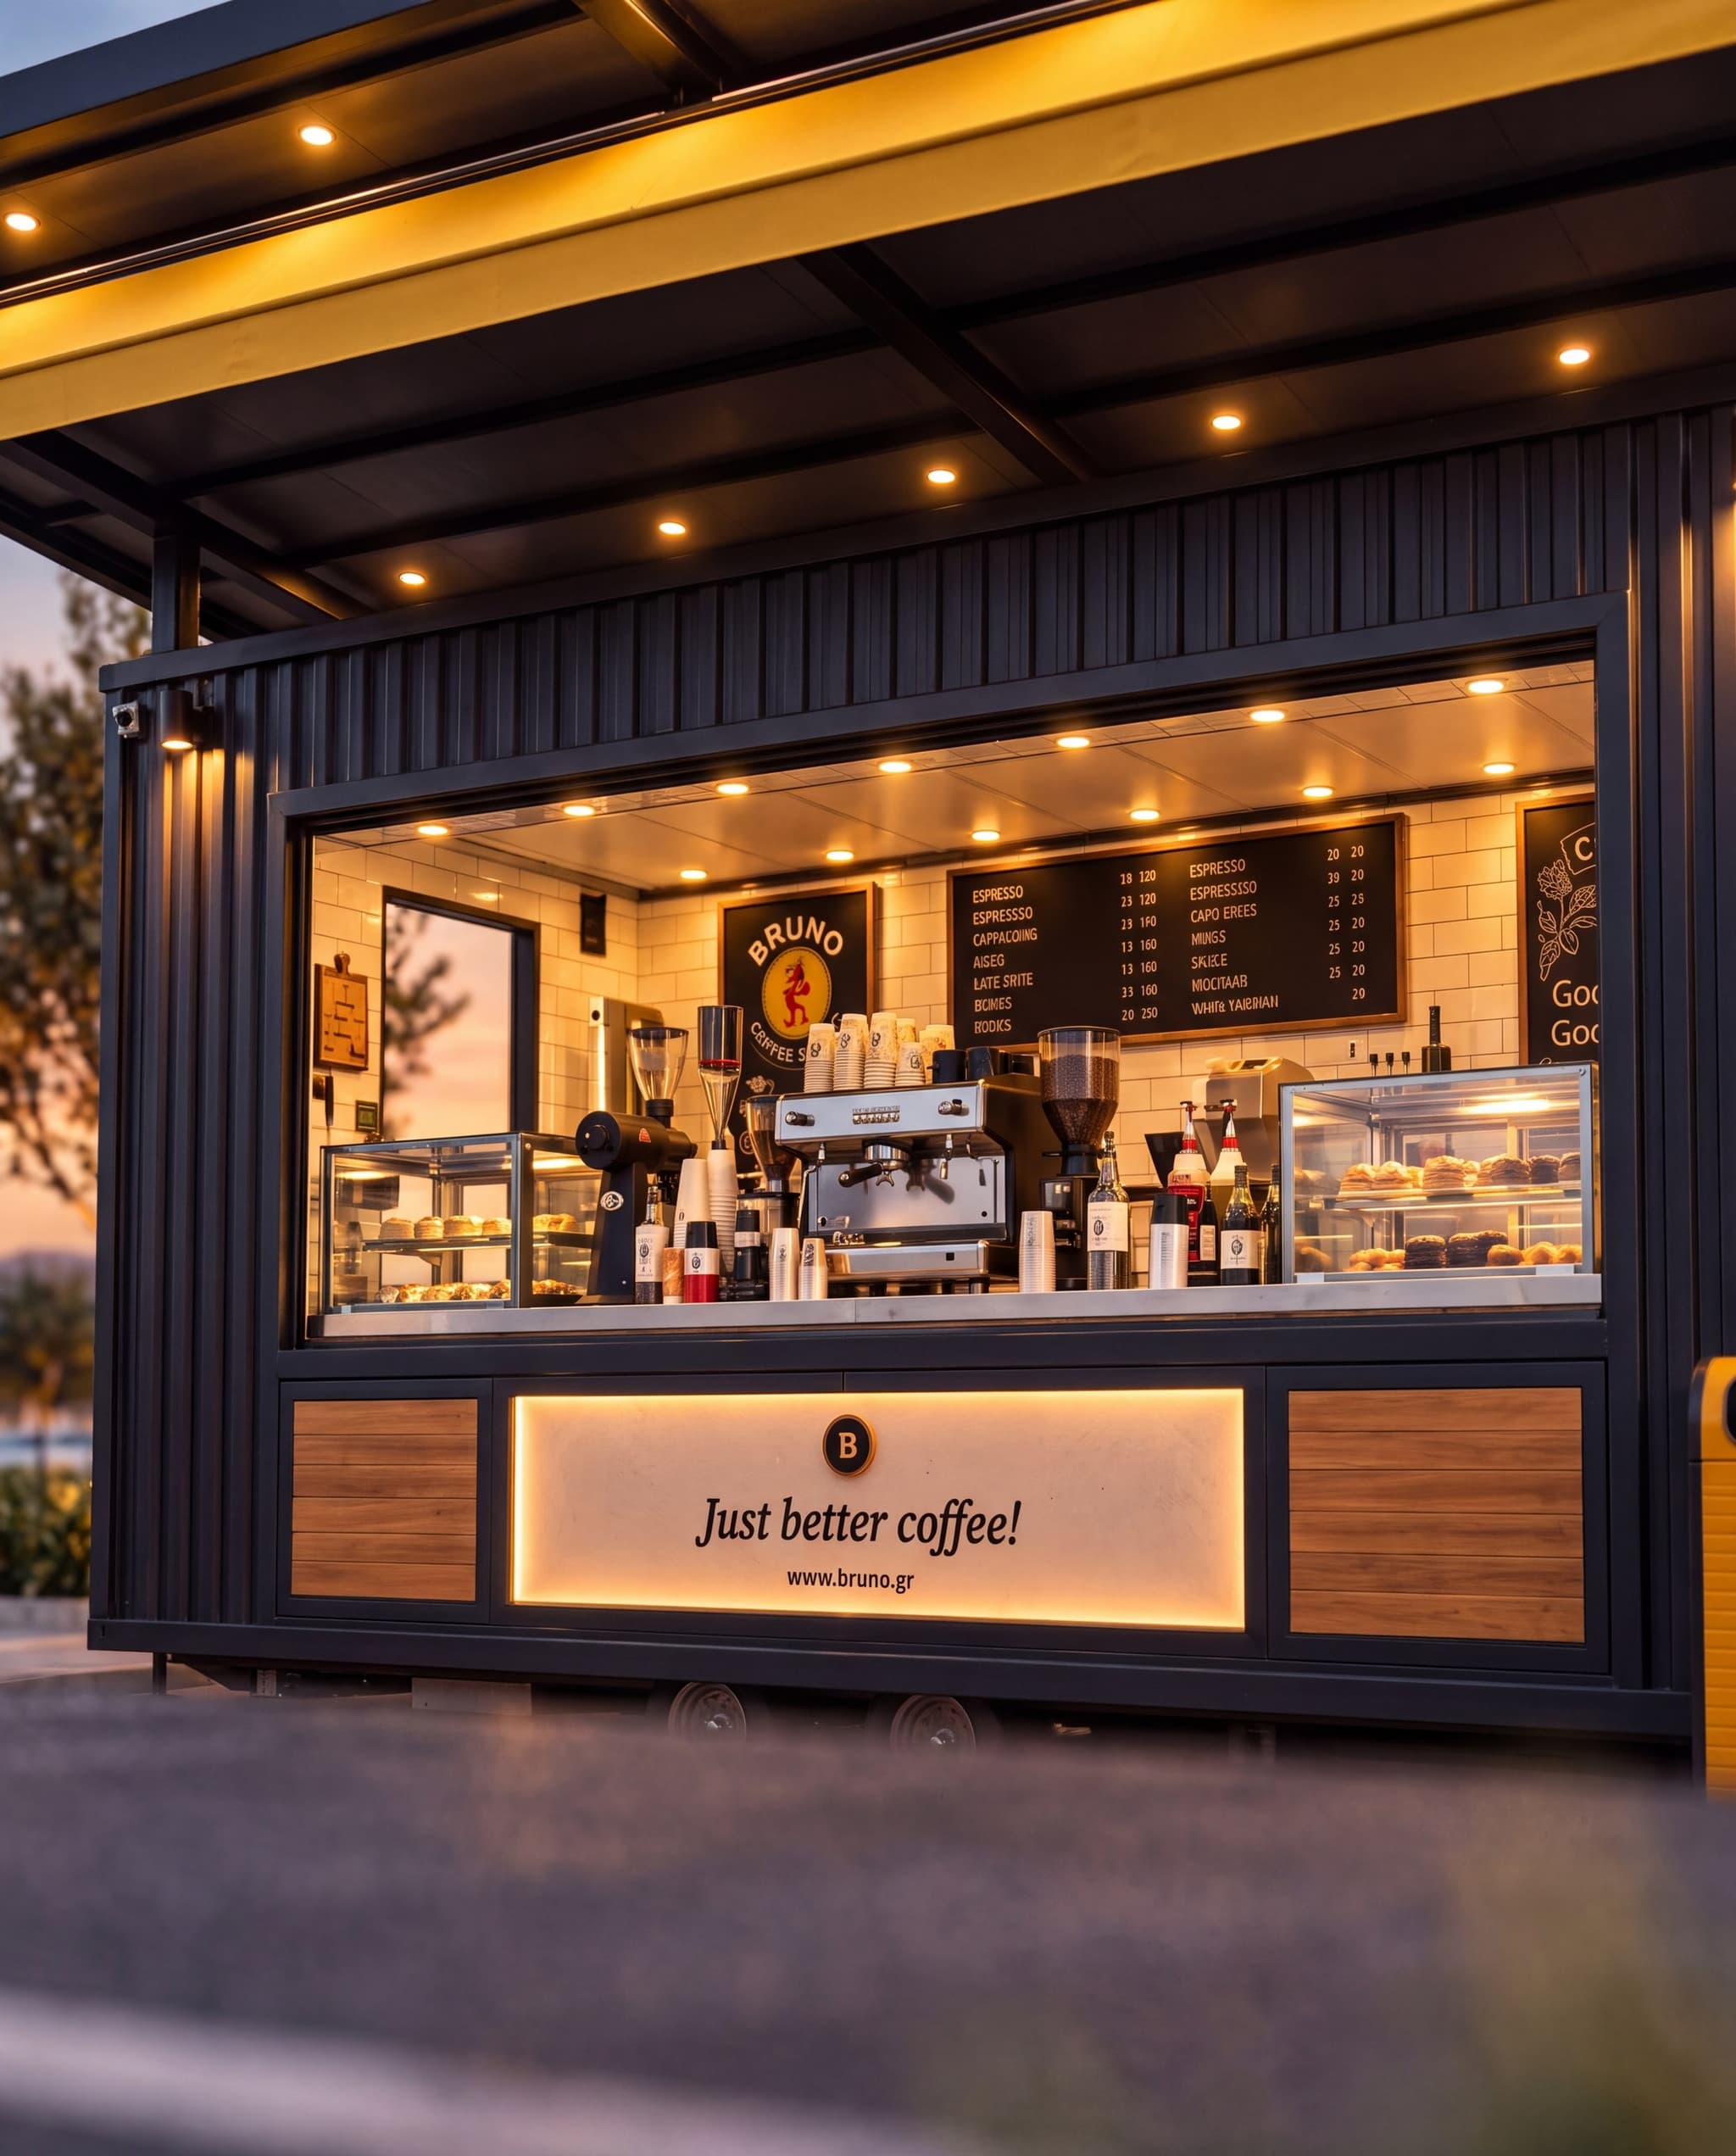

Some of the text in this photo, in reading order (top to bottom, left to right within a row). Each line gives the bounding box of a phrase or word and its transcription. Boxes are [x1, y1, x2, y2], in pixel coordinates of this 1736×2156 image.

[1189, 844, 1364, 878] ESPRESSO 20 20
[1351, 868, 1365, 882] 20
[972, 885, 1024, 904] ESPRESSO
[1139, 869, 1157, 883] 120
[1121, 895, 1133, 908] 23
[1139, 892, 1157, 905] 120
[1190, 908, 1220, 923] CAPO
[1223, 904, 1257, 920] EREES
[1328, 894, 1340, 908] 25
[1328, 919, 1340, 932] 25
[1352, 916, 1365, 929] 20
[748, 915, 843, 967] BRUNO
[1121, 940, 1133, 953] 13
[1140, 938, 1157, 951] 160
[1328, 943, 1341, 955] 25
[1352, 940, 1365, 953] 20
[1121, 963, 1133, 976] 13
[1141, 961, 1157, 973] 160
[1329, 966, 1341, 979] 25
[1352, 964, 1366, 977] 20
[1141, 983, 1158, 996] 160
[1352, 987, 1366, 1000] 20
[1121, 1009, 1135, 1022] 20
[1141, 1006, 1158, 1020] 250
[838, 1432, 858, 1459] B
[695, 1496, 1021, 1557] Just better coffee!
[787, 1568, 914, 1594] www.bruno.gr
